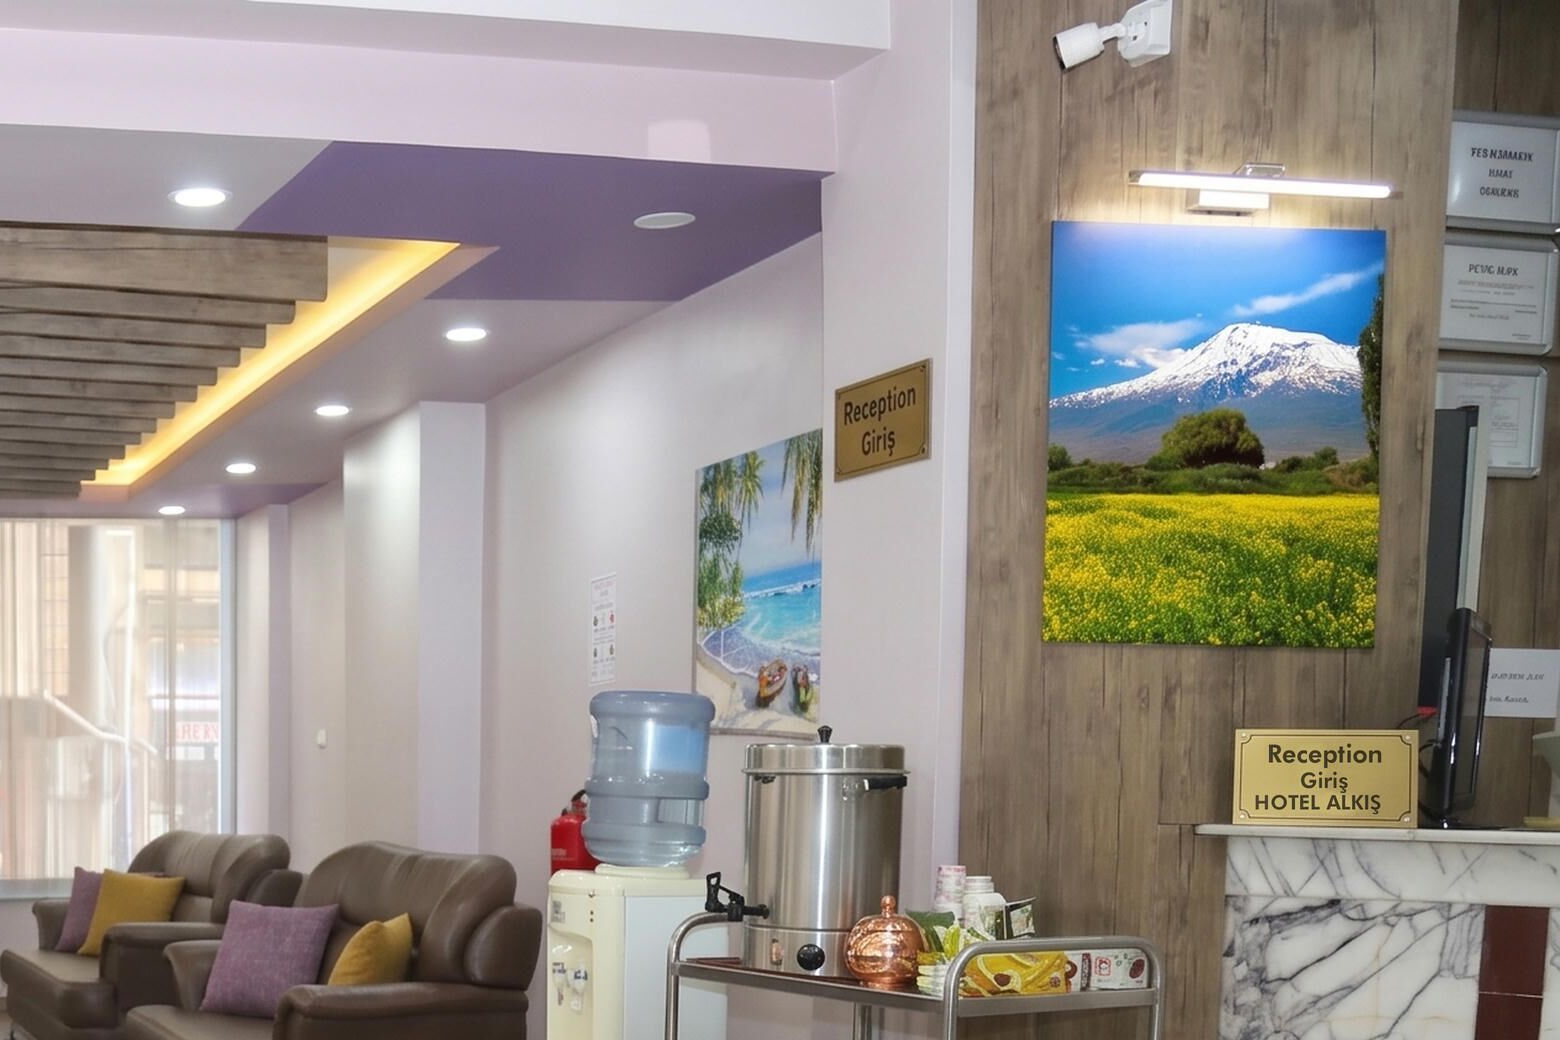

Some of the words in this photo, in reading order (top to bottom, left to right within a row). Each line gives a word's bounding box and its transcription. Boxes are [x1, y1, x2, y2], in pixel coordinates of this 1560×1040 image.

[843, 386, 916, 426] Reception
[861, 427, 896, 457] Giriş
[1268, 743, 1382, 768] Reception
[1300, 771, 1348, 793] Giriş
[1255, 794, 1320, 810] HOTEL
[1326, 794, 1381, 814] ALKIŞ
